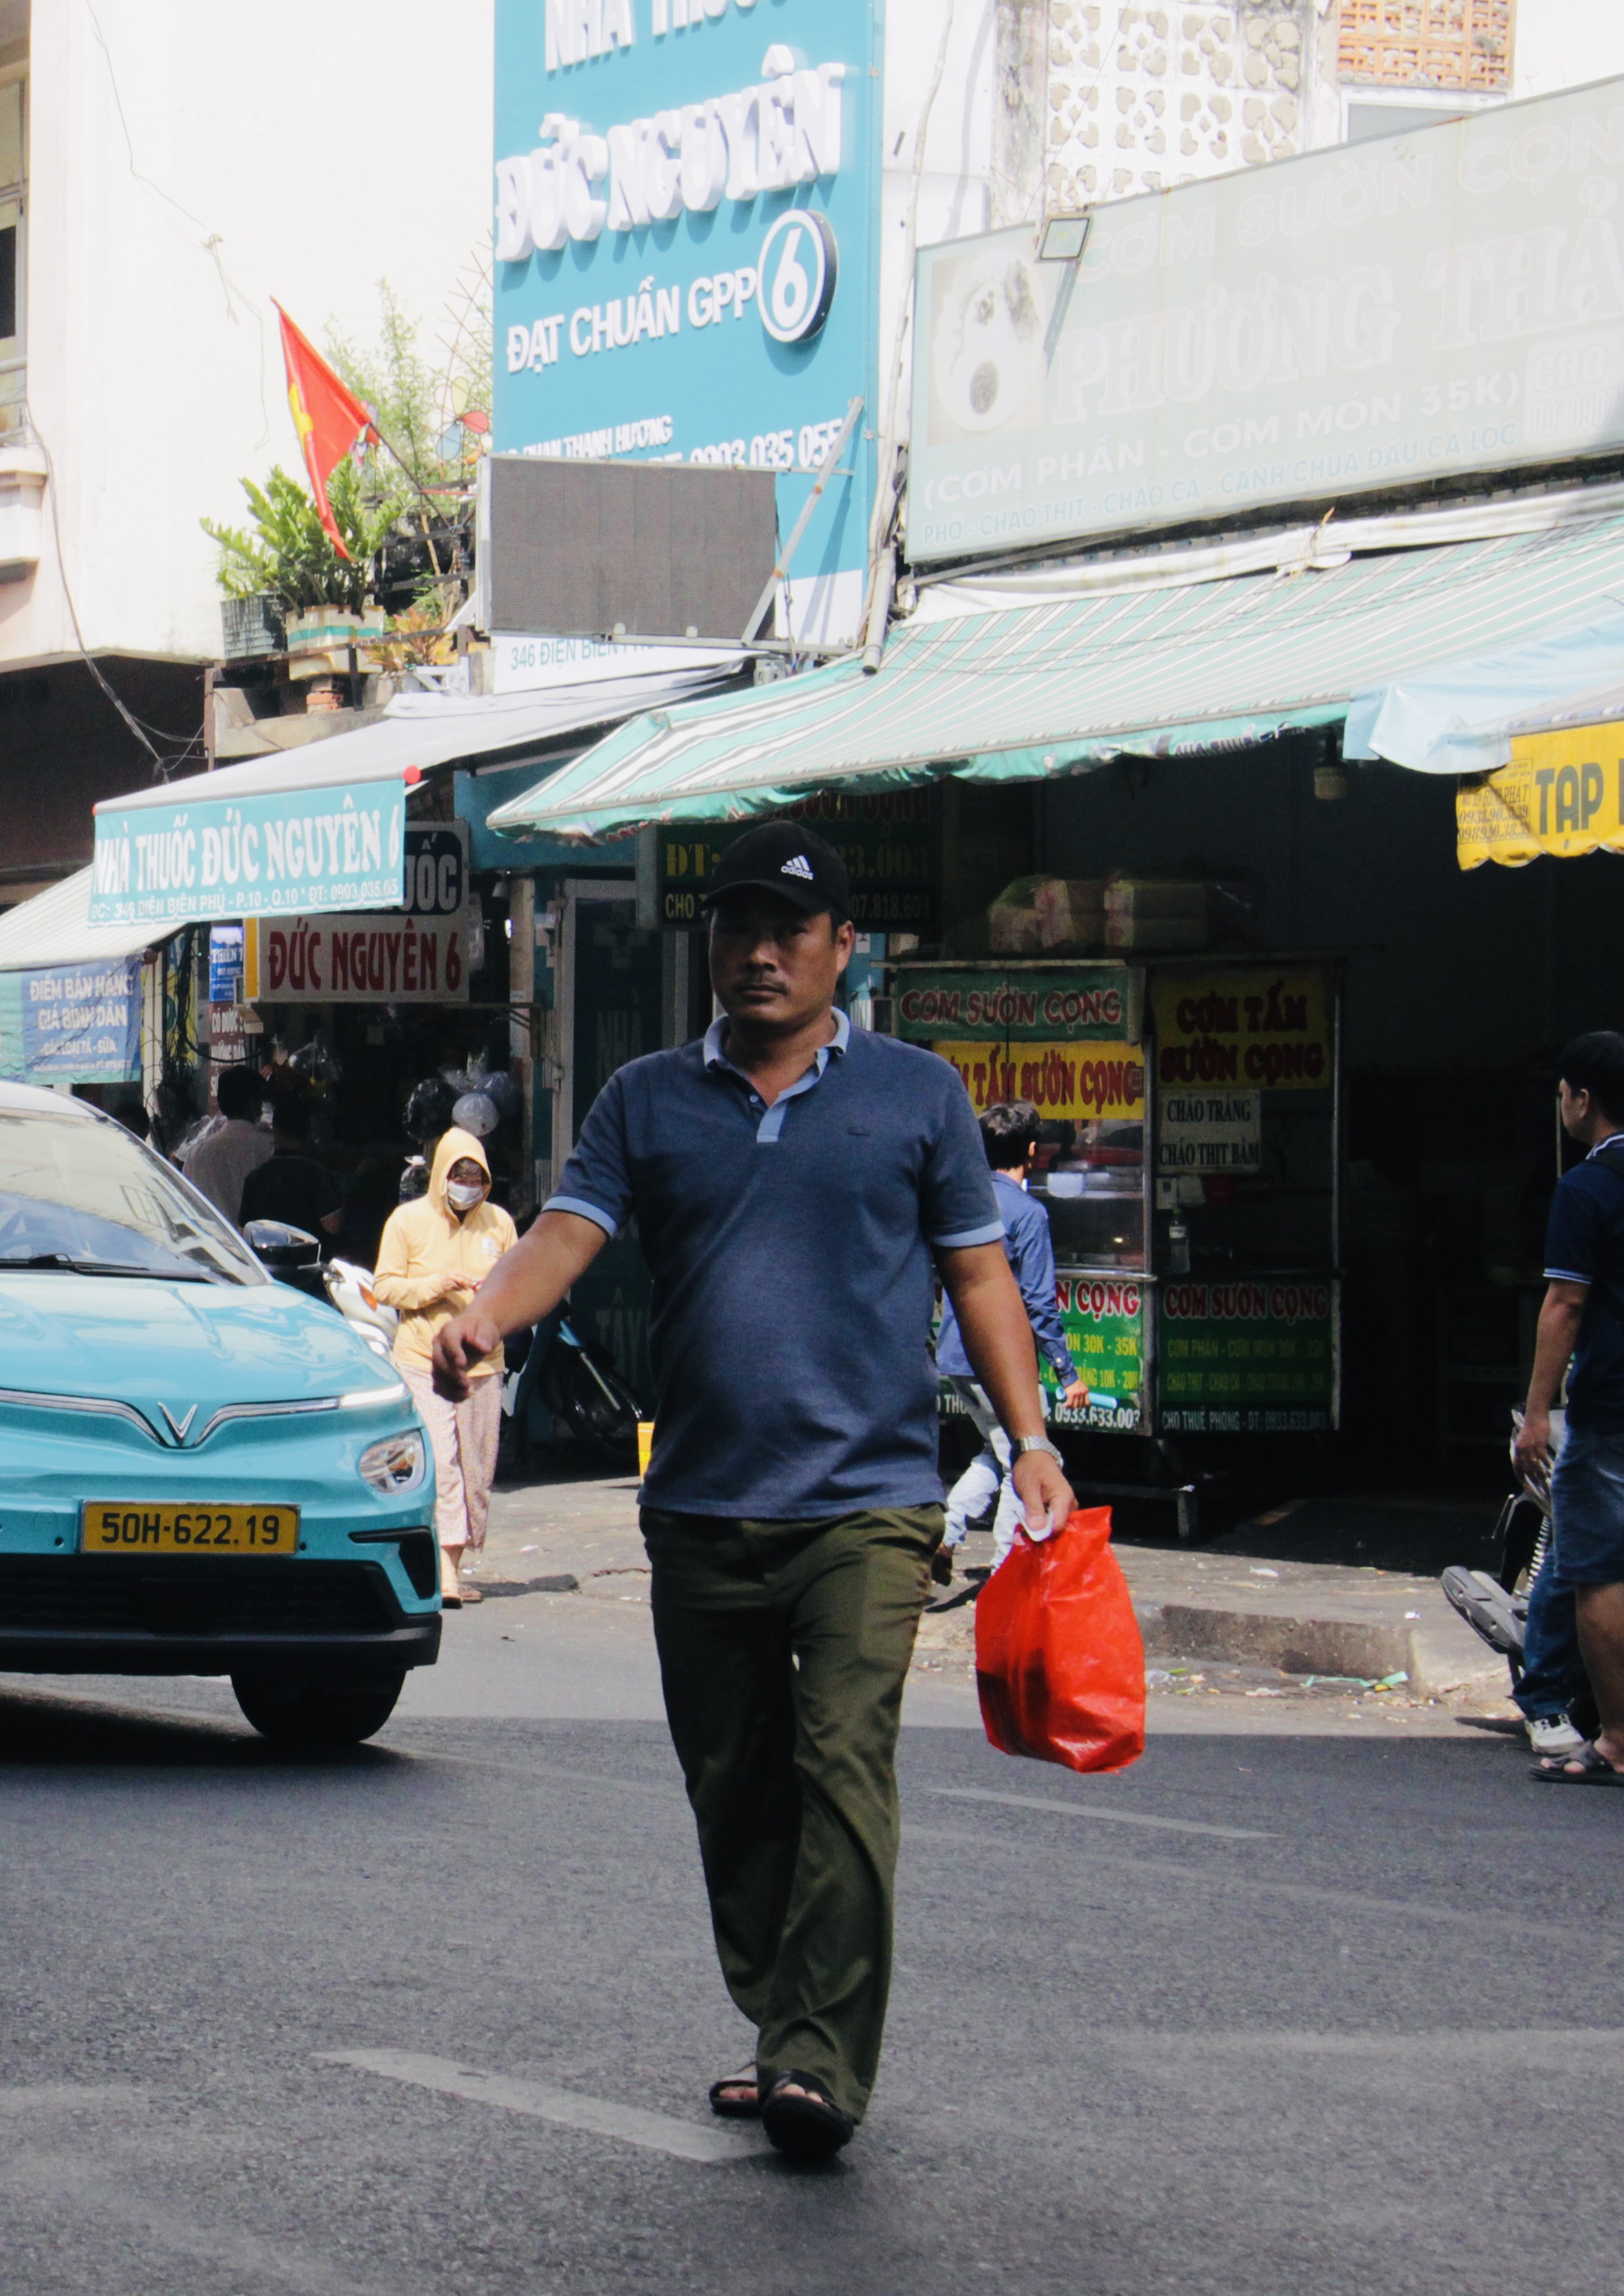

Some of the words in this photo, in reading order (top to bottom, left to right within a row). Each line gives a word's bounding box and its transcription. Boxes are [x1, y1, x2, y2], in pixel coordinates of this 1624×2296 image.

[495, 113, 607, 262] ĐỨC
[607, 44, 847, 231] NGUYÊN
[1237, 152, 1434, 248] SƯỜN
[771, 227, 809, 330] 6
[507, 315, 565, 373] ĐẠT
[570, 276, 680, 357] CHUẨN
[688, 267, 758, 328] GPP
[1052, 264, 1402, 425] PHƯƠNG
[1532, 343, 1608, 393] CHO
[614, 415, 674, 452] HƯƠNG
[749, 429, 795, 468] 035
[924, 463, 1022, 512] (CƠM
[1038, 433, 1145, 485] PHẦN
[1183, 414, 1279, 459] CƠM
[1296, 391, 1402, 440] MÓN
[1419, 369, 1521, 417] 35K)
[979, 500, 1038, 537] CHÁO
[1042, 496, 1086, 527] THỊT
[1169, 472, 1201, 507] CÁ
[1220, 463, 1285, 495] CANH
[1292, 451, 1360, 486] CHUA
[1427, 425, 1462, 460] CÁ
[1468, 416, 1520, 452] LÓC
[510, 643, 536, 671] 346
[94, 821, 131, 895] NHÀ
[136, 813, 196, 891] THUỐC
[201, 807, 259, 887] ĐỨC
[266, 792, 381, 881] NGUYÊN
[388, 804, 401, 871] 6
[780, 865, 814, 881] adidas
[114, 901, 136, 918] 346
[167, 892, 197, 914] BIÊN
[200, 887, 226, 912] PHỦ
[235, 891, 261, 908] P.10
[272, 887, 298, 906] Q.10
[309, 886, 328, 903] ĐT:
[665, 892, 695, 919] CHO
[268, 917, 322, 991] ĐỨC
[330, 917, 438, 992] NGUYÊN
[446, 931, 462, 992] 6
[65, 972, 93, 999] BÁN
[901, 985, 961, 1024] CƠM
[966, 982, 1038, 1026] SƯỜN
[1044, 989, 1121, 1034] CỌNG
[1176, 990, 1239, 1034] CƠM
[1243, 979, 1308, 1033] TẤM
[38, 1003, 61, 1030] GIÁ
[96, 999, 128, 1028] DÂN
[1021, 1049, 1075, 1106] SƯỜN
[1080, 1060, 1137, 1115] CỌNG
[1160, 1035, 1239, 1082] SƯỜN
[1245, 1042, 1325, 1087] CỌNG
[1166, 1093, 1206, 1122] CHÁO
[1160, 1135, 1195, 1165] CHÁO
[1075, 1281, 1142, 1323] CỌNG
[1164, 1283, 1208, 1320] CƠM
[1211, 1281, 1268, 1321] SƯỜN
[1270, 1284, 1329, 1327] CỌNG
[1065, 1327, 1082, 1352] ÓN
[1083, 1334, 1104, 1354] 30K
[1115, 1336, 1138, 1357] 35K
[1162, 1410, 1181, 1431] CHO
[102, 1512, 280, 1545] 50H-622.19
